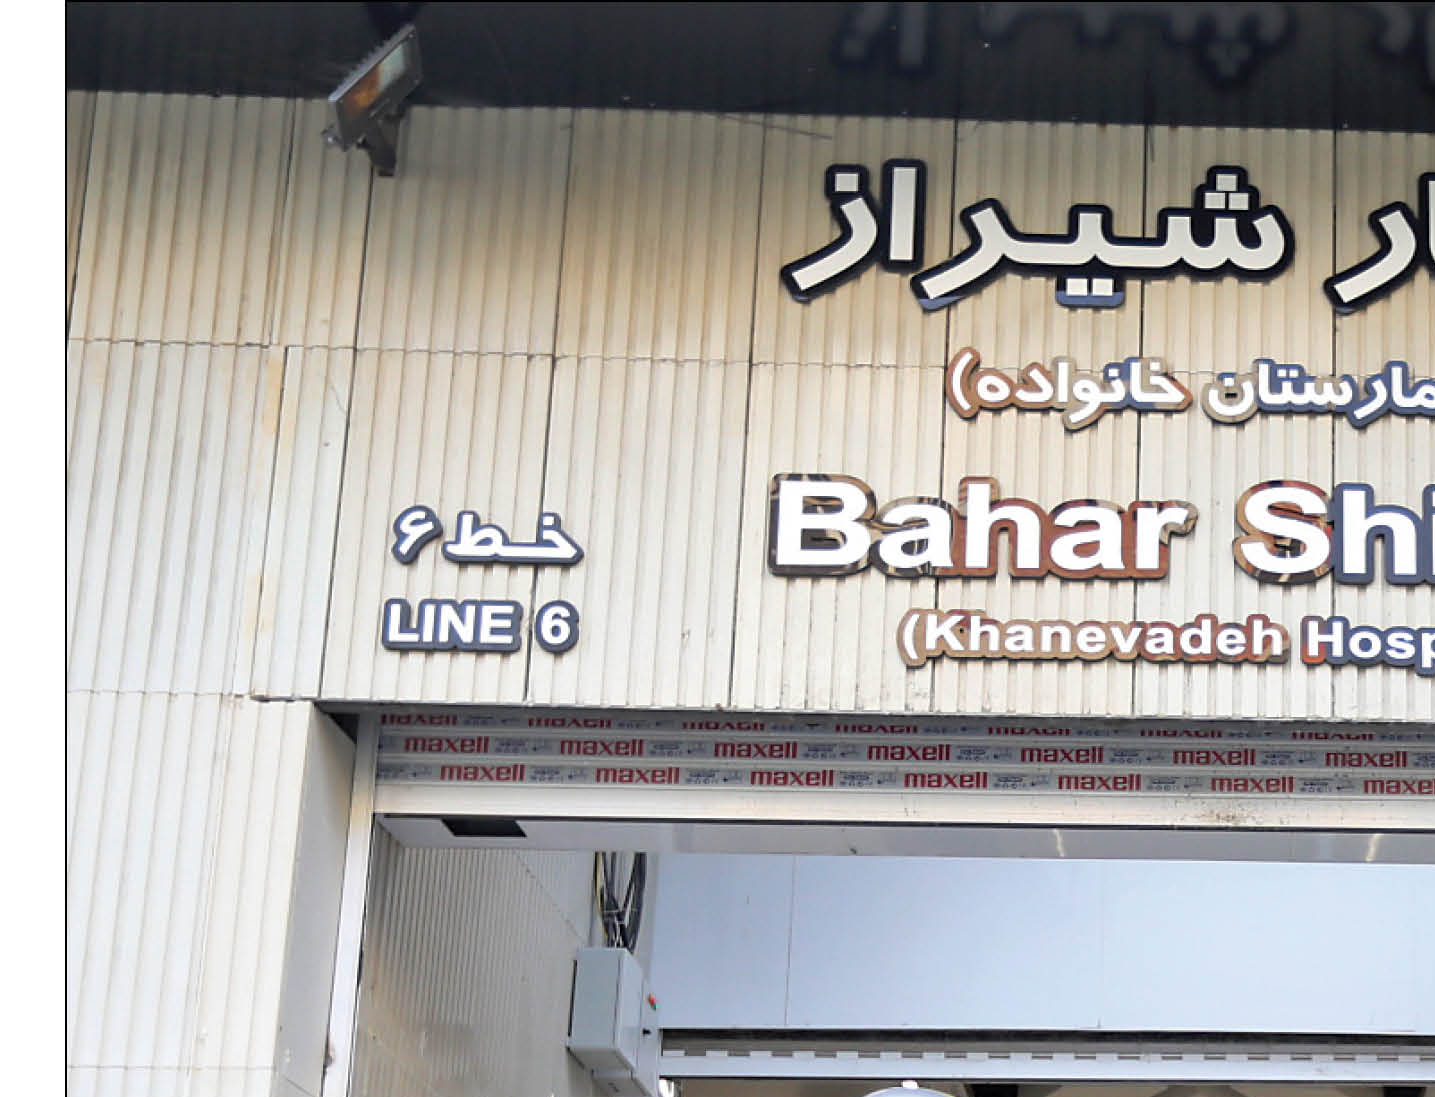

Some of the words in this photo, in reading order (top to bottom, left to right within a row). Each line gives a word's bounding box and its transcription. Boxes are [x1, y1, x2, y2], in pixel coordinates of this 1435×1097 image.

[787, 162, 1289, 304] شیراز
[950, 350, 1187, 426] خانواده)
[443, 512, 580, 561] خط
[773, 477, 1191, 574] Bahar
[386, 602, 517, 646] LINE
[539, 603, 574, 648] 6
[902, 612, 1285, 661] (Khanevadeh
[405, 735, 489, 753] maxell
[559, 740, 644, 756] maxell
[714, 742, 799, 759] maxell
[867, 743, 951, 761] maxell
[1021, 746, 1105, 763] maxell
[1173, 749, 1257, 766] maxell
[1325, 751, 1409, 768] maxell
[439, 763, 526, 783] maxell
[594, 767, 681, 785] maxell
[749, 769, 836, 788] maxell
[903, 771, 988, 790] maxell
[1057, 775, 1142, 792] maxell
[1210, 775, 1296, 793] maxell
